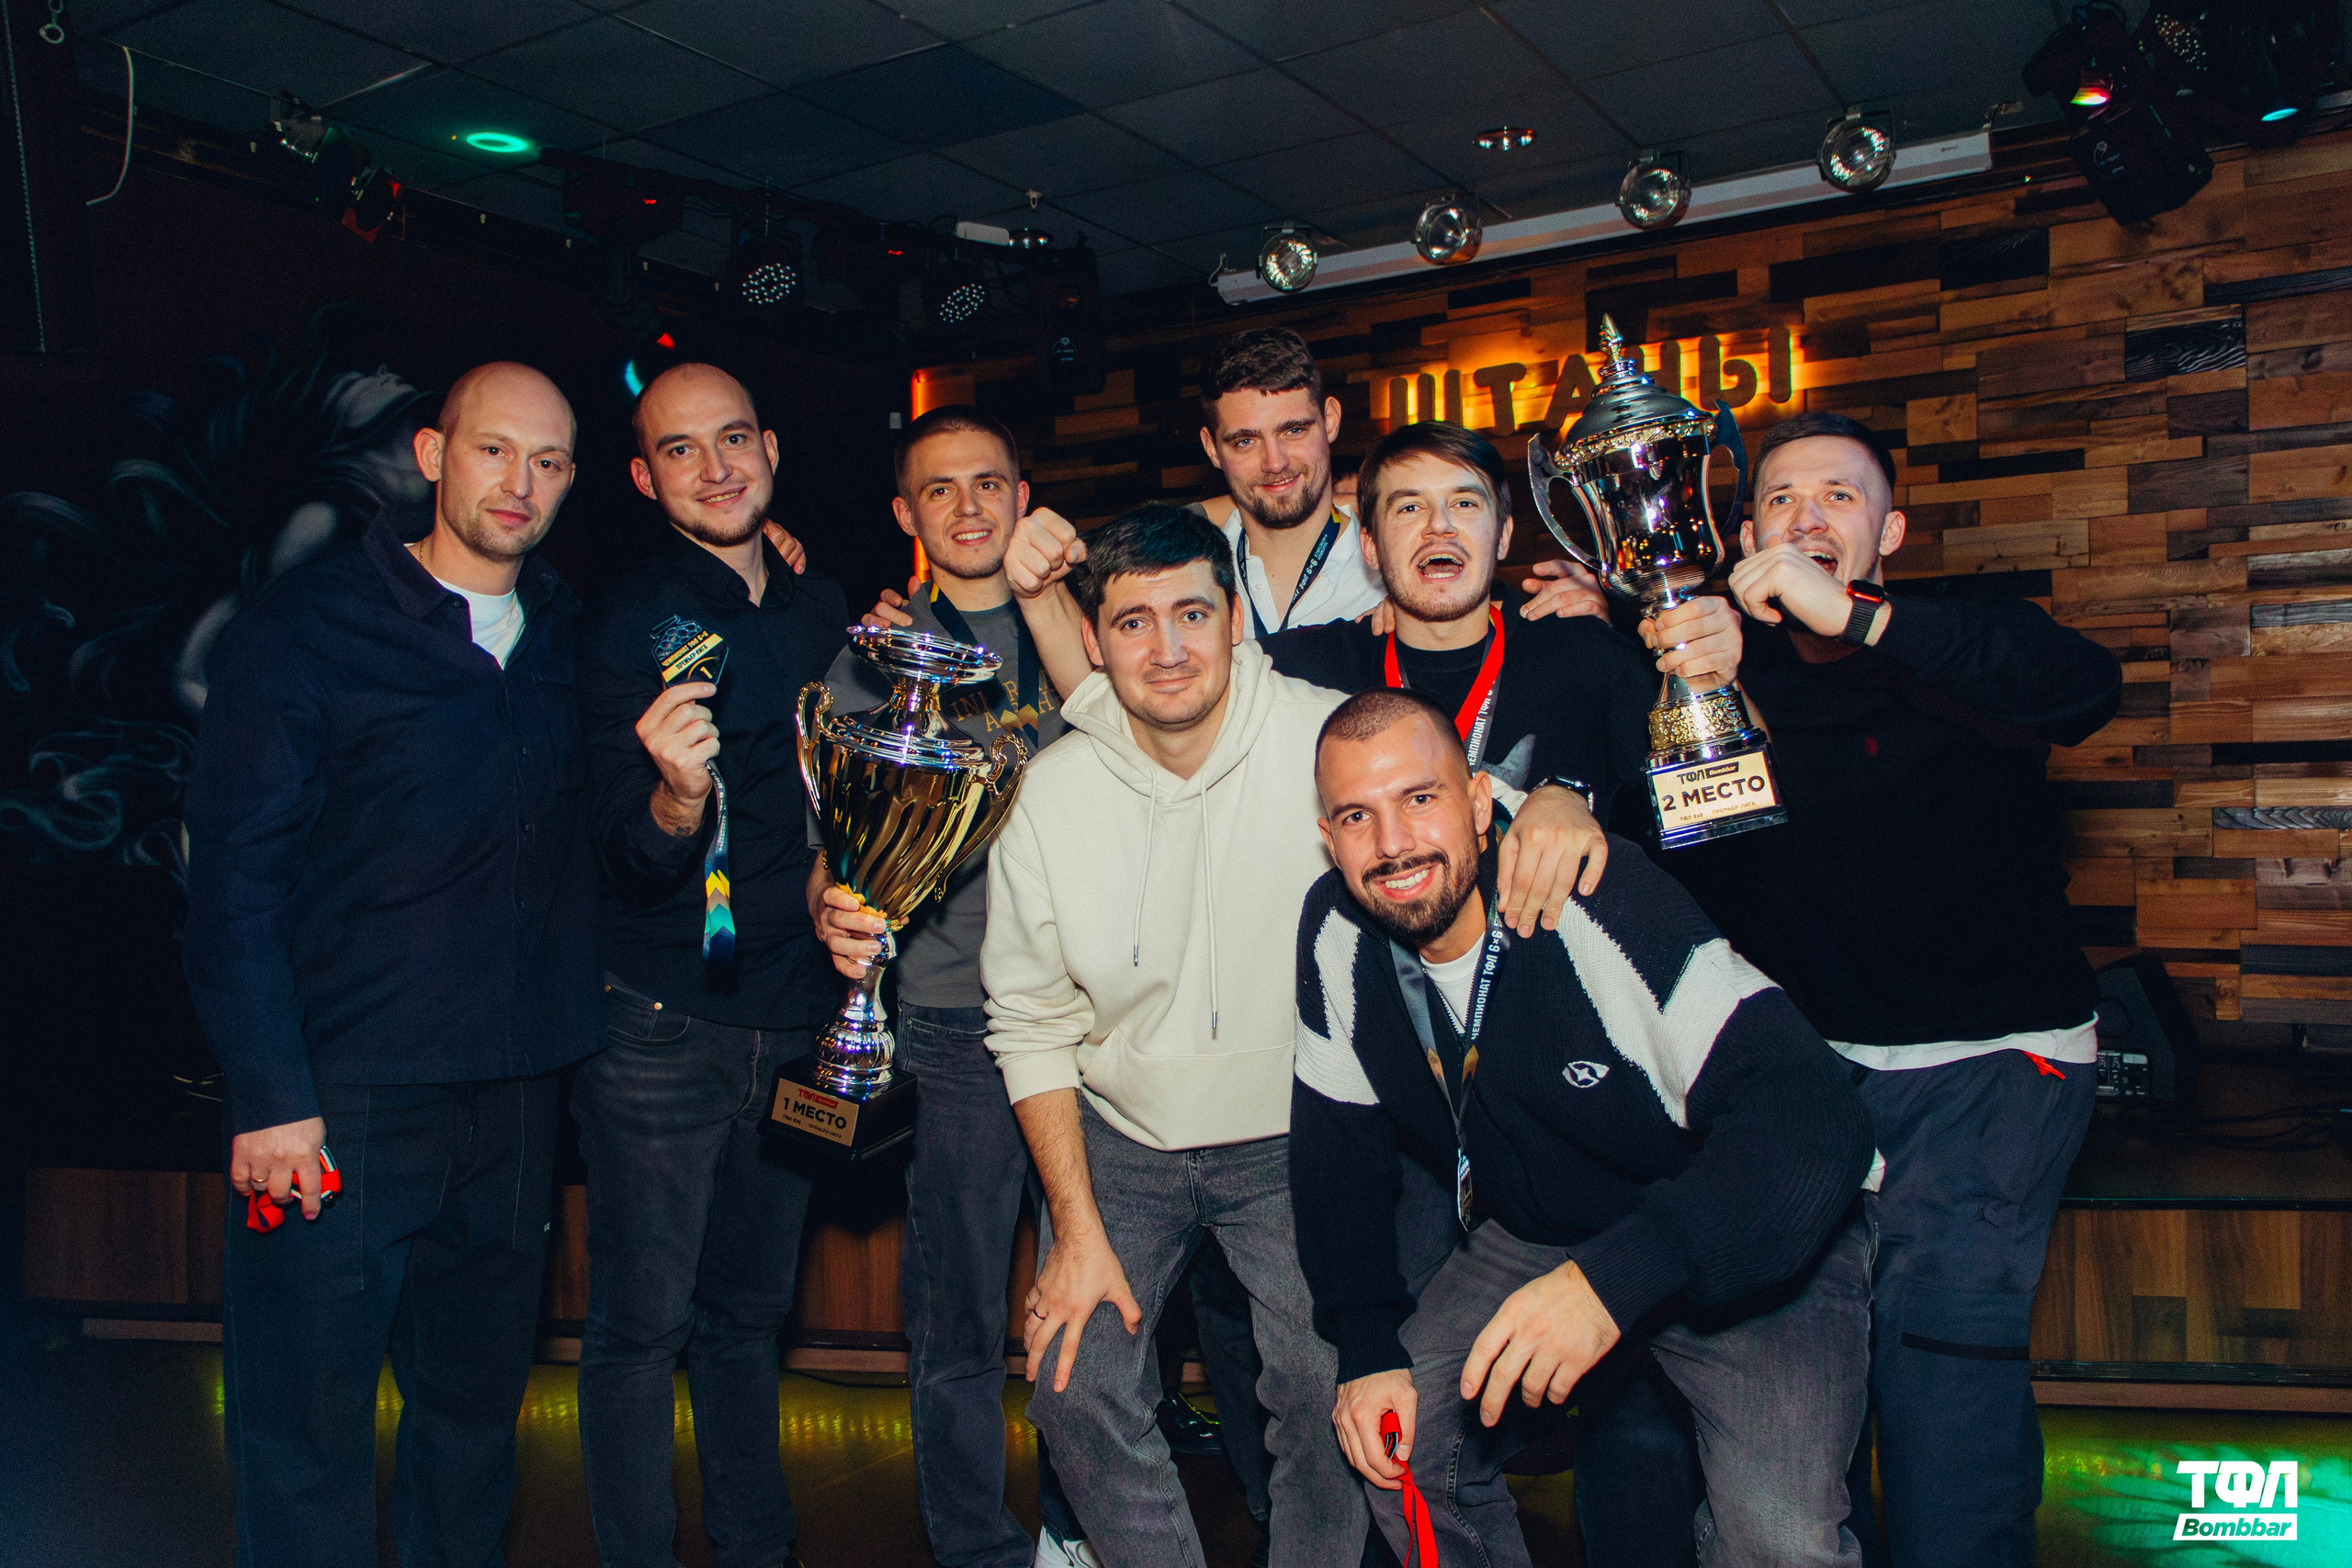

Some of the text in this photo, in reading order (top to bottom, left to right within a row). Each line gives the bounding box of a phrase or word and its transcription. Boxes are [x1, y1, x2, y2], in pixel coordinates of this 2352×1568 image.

[1389, 327, 1792, 436] ШТАНЫ
[699, 666, 713, 679] 1
[1661, 775, 1765, 811] 2 МЕСТО
[1677, 769, 1705, 784] ТФЛ
[1679, 814, 1692, 822] ТФЛ
[1712, 801, 1757, 815] ПРЕМЬЕР-ЛИГА
[1471, 977, 1491, 1040] ЧЕМПИОНАТ
[1482, 954, 1498, 976] ТФЛ
[784, 1097, 847, 1130] 1 МЕСТО
